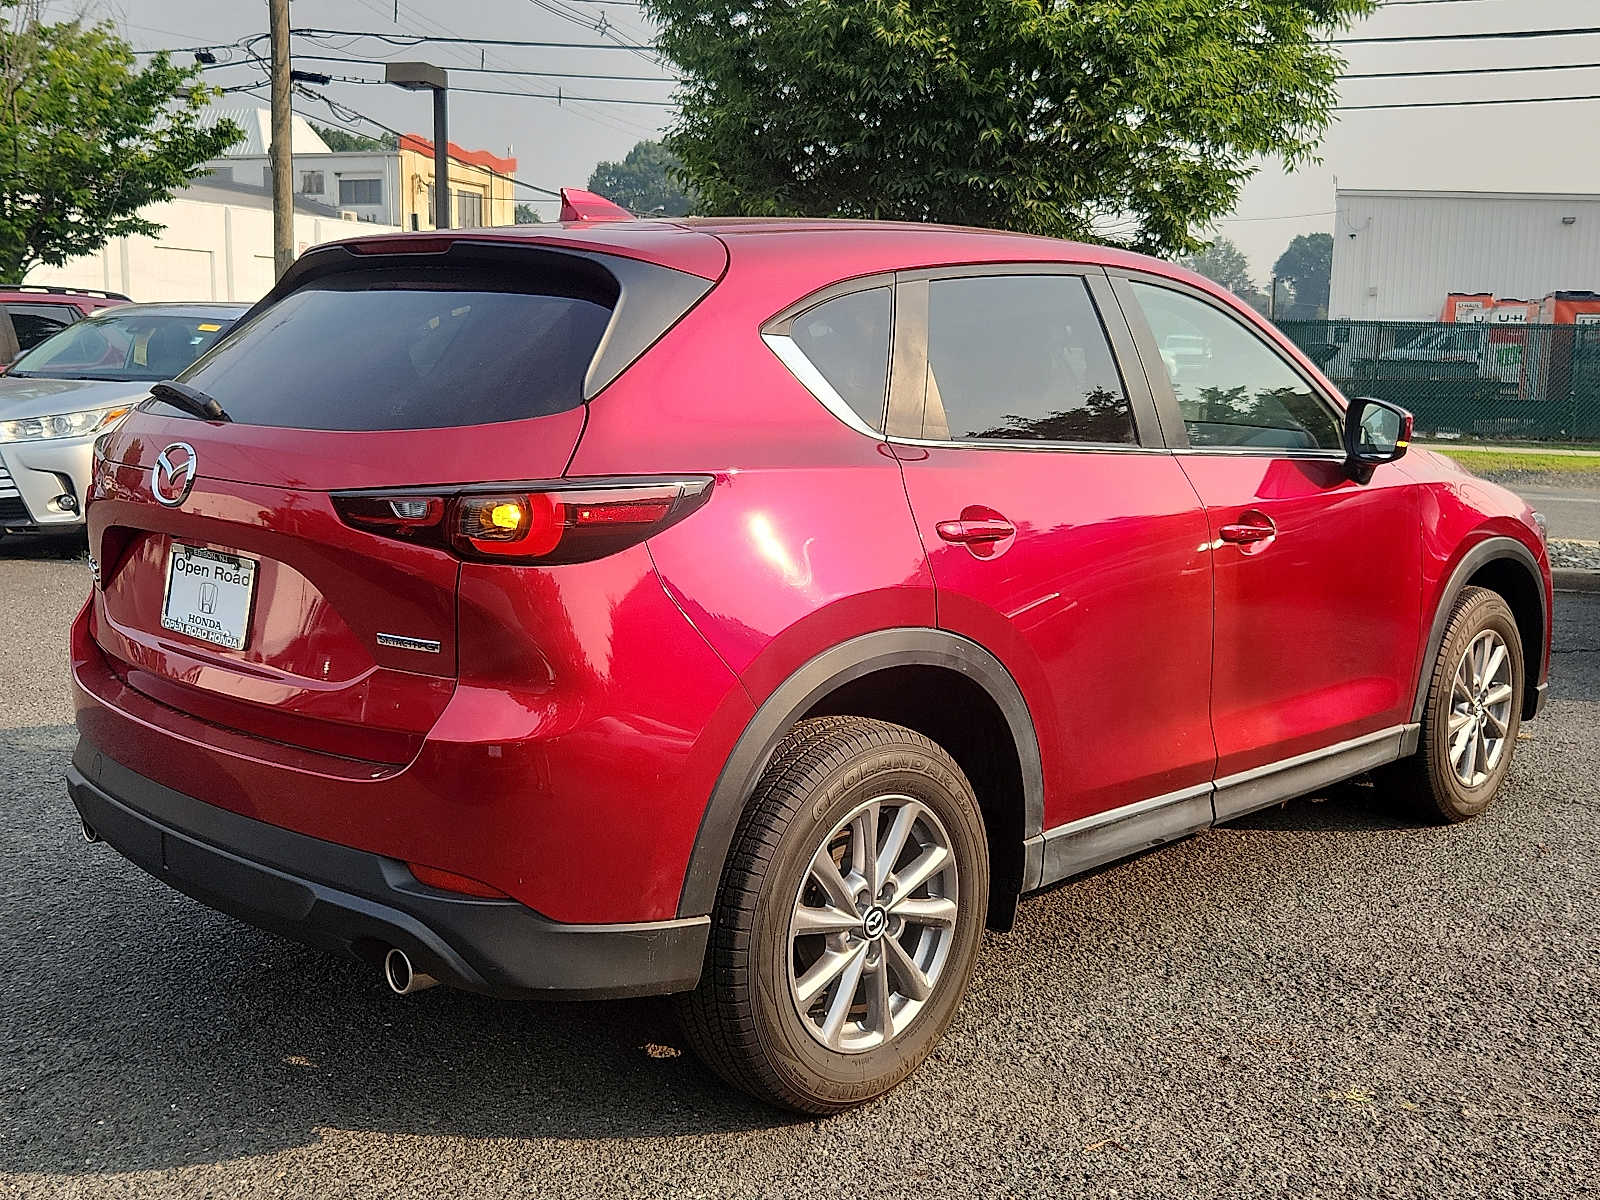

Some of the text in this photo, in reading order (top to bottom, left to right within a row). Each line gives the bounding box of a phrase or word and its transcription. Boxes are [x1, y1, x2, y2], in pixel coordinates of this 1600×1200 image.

[176, 558, 251, 587] Open Road
[164, 618, 239, 649] OPEN ROAD HONDA
[188, 613, 222, 631] HONDA
[811, 753, 955, 822] GEOLANDAR
